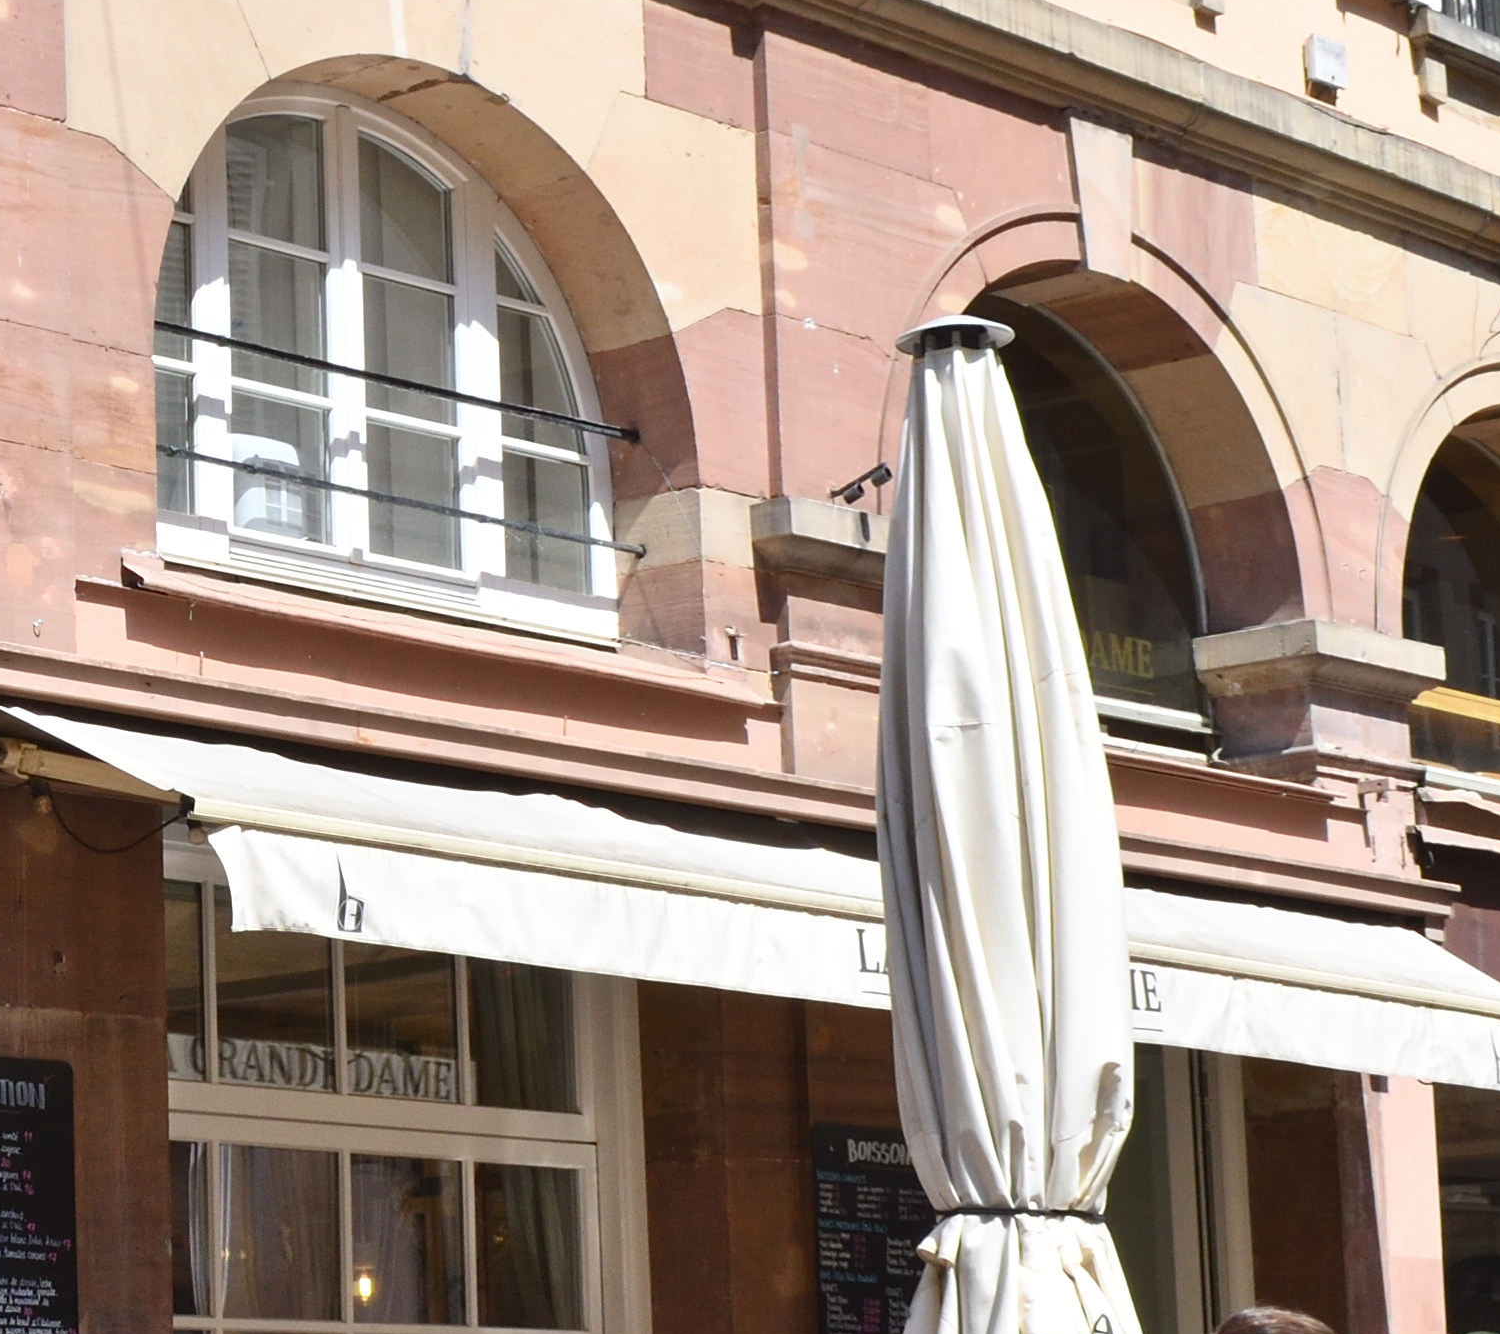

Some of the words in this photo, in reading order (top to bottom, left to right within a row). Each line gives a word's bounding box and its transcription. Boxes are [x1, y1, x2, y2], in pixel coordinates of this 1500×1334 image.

[1082, 630, 1153, 679] AME
[857, 929, 887, 974] L
[354, 1051, 450, 1100] DAME
